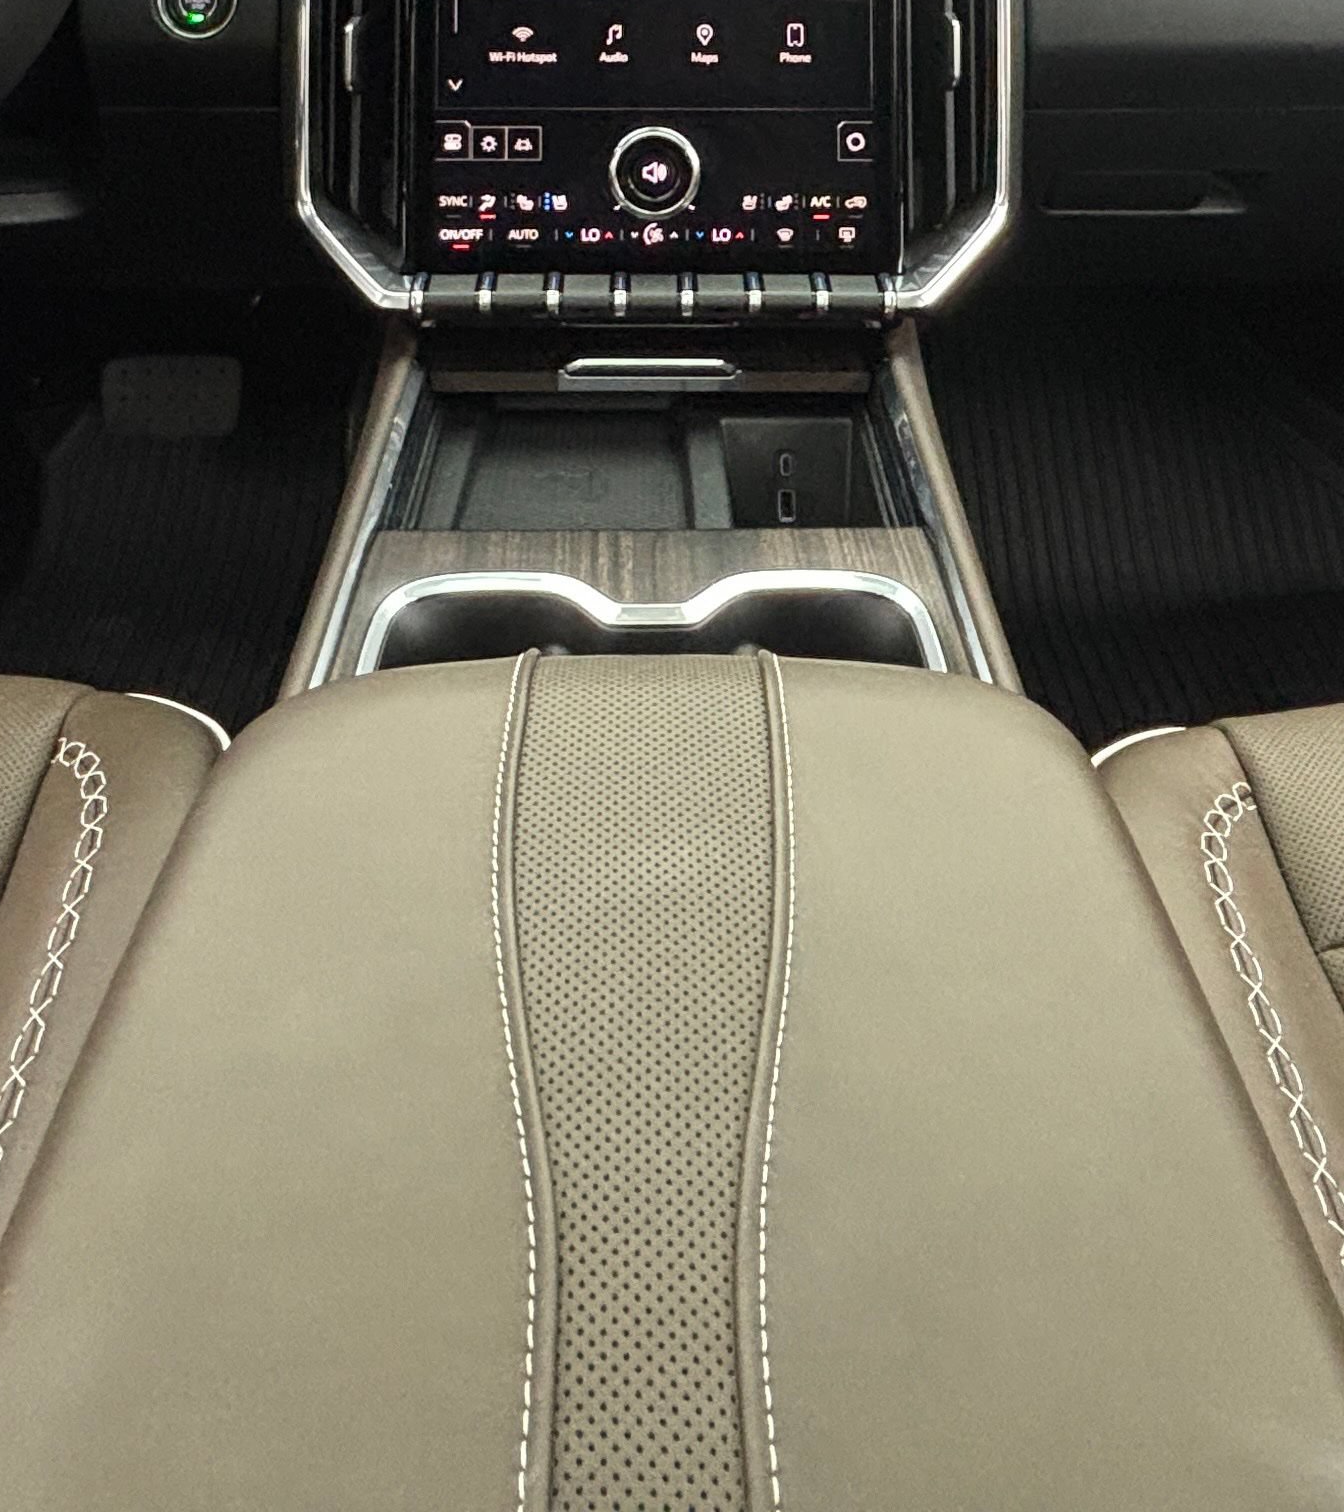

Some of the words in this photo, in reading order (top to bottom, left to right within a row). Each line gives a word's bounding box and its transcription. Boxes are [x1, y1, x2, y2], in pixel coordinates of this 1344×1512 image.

[489, 50, 516, 63] Wi-Fi
[516, 50, 557, 65] Hotspot
[599, 51, 628, 64] Audio
[691, 51, 719, 65] Maps
[779, 51, 812, 64] Phone
[438, 195, 468, 207] SYNC
[810, 196, 831, 208] A/C
[439, 229, 483, 240] ON/OFF
[508, 229, 539, 241] AUTO
[580, 228, 600, 242] LO
[712, 228, 732, 242] LO
